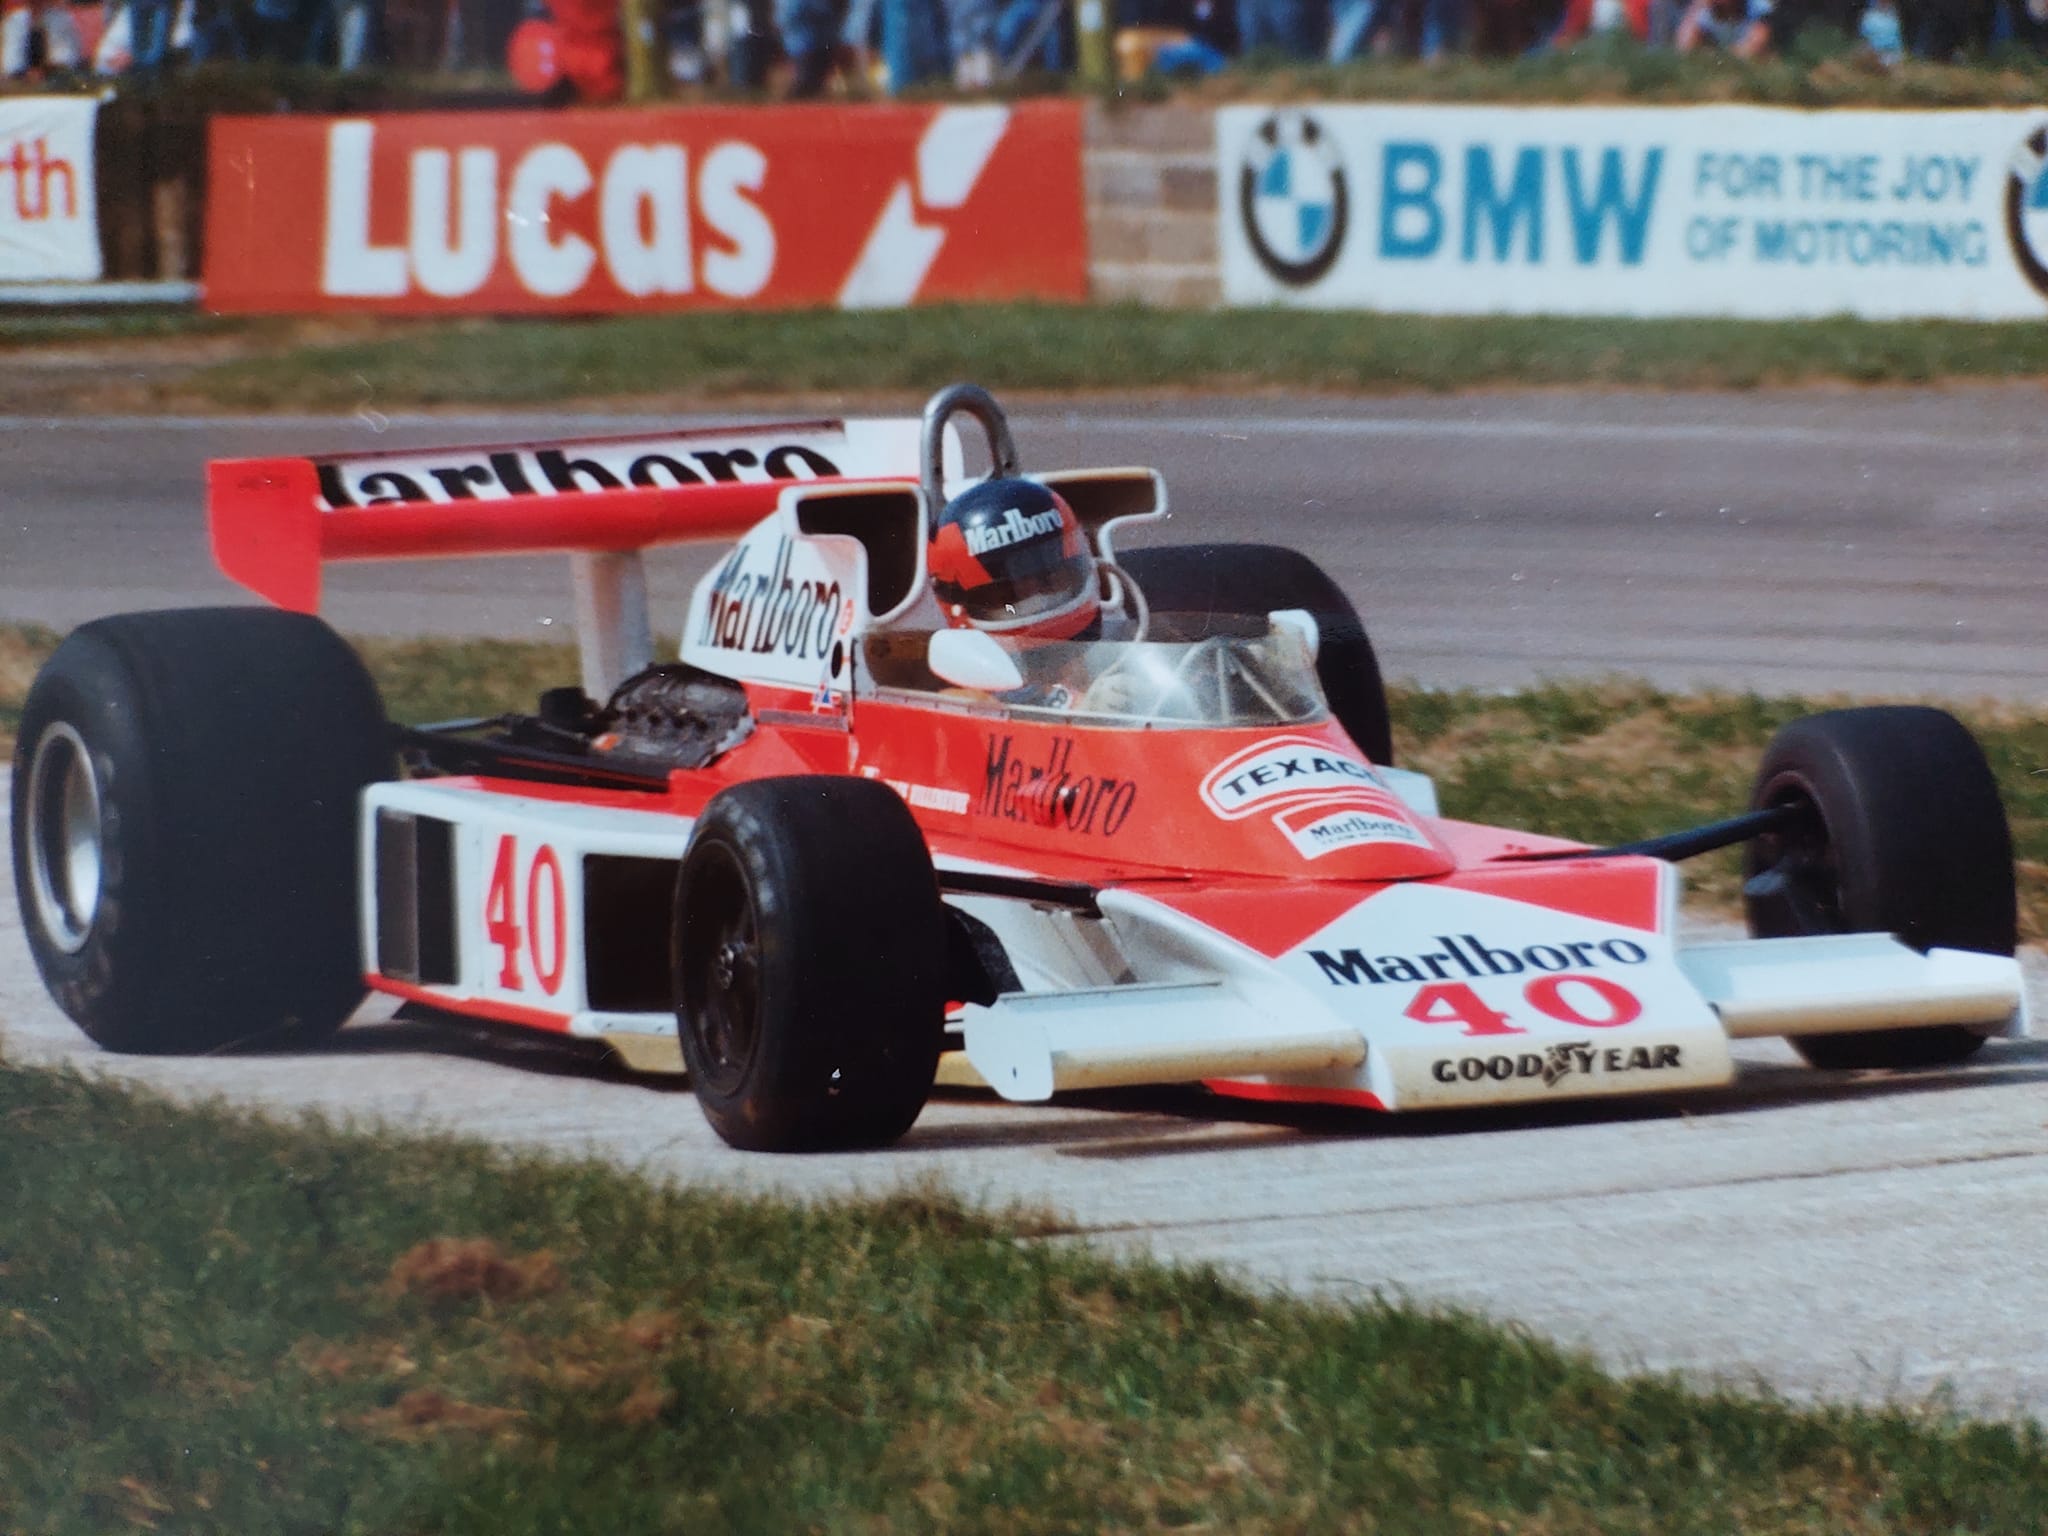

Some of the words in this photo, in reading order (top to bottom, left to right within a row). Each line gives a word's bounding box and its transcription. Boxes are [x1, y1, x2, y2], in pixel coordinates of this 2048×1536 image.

[322, 119, 778, 298] Lucas
[1378, 142, 1668, 266] BMW
[1695, 154, 1783, 198] FOR
[1797, 154, 1880, 201] THE
[1891, 155, 1982, 201] JOY
[1687, 217, 1739, 262] OF
[1755, 219, 1987, 265] MOTORING
[964, 508, 1064, 558] Marlboro
[698, 535, 841, 660] Marlboro
[978, 732, 1138, 836] Marlboro
[486, 833, 566, 996] 40
[1306, 934, 1648, 986] Marlboro
[1403, 973, 1643, 1036] 40
